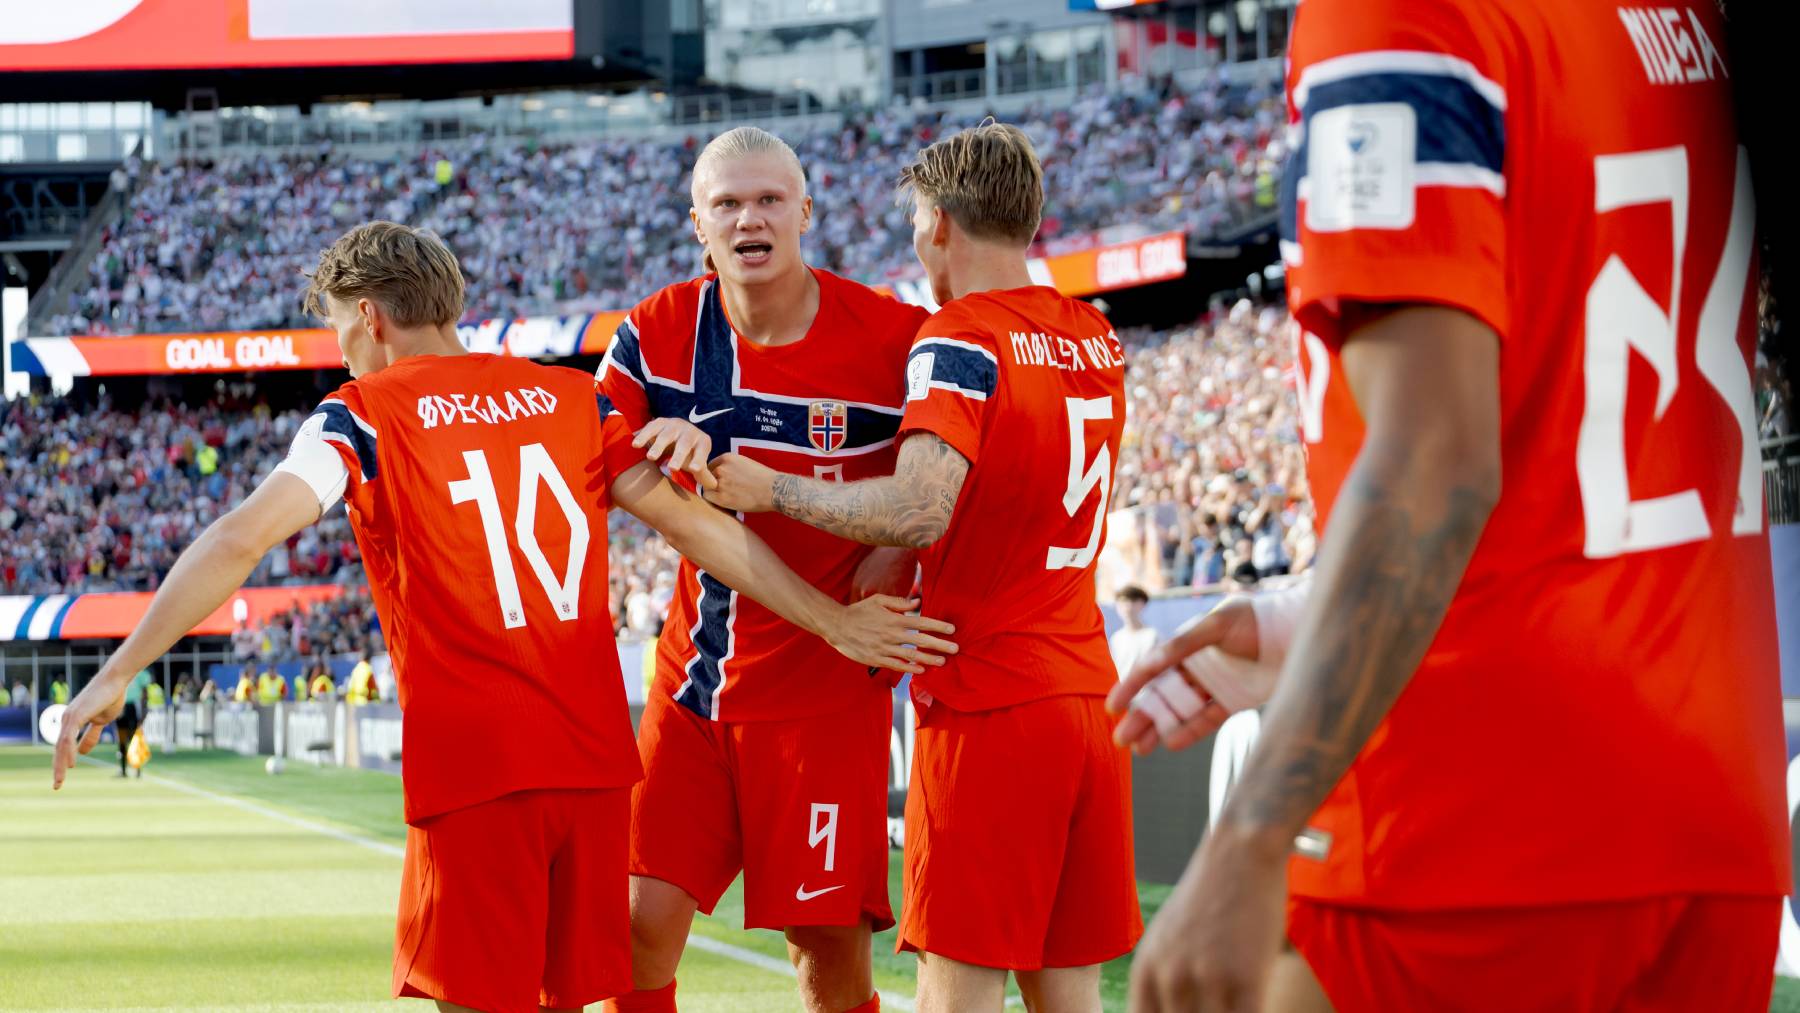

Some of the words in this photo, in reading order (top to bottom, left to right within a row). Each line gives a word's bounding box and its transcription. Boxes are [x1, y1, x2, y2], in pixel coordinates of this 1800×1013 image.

[1617, 6, 1729, 85] NUSA
[166, 338, 232, 369] GOAL
[235, 335, 299, 367] GOAL
[417, 386, 558, 429] ØDEGAARD
[1046, 396, 1113, 569] 5
[448, 443, 590, 629] 10
[808, 803, 839, 871] 9
